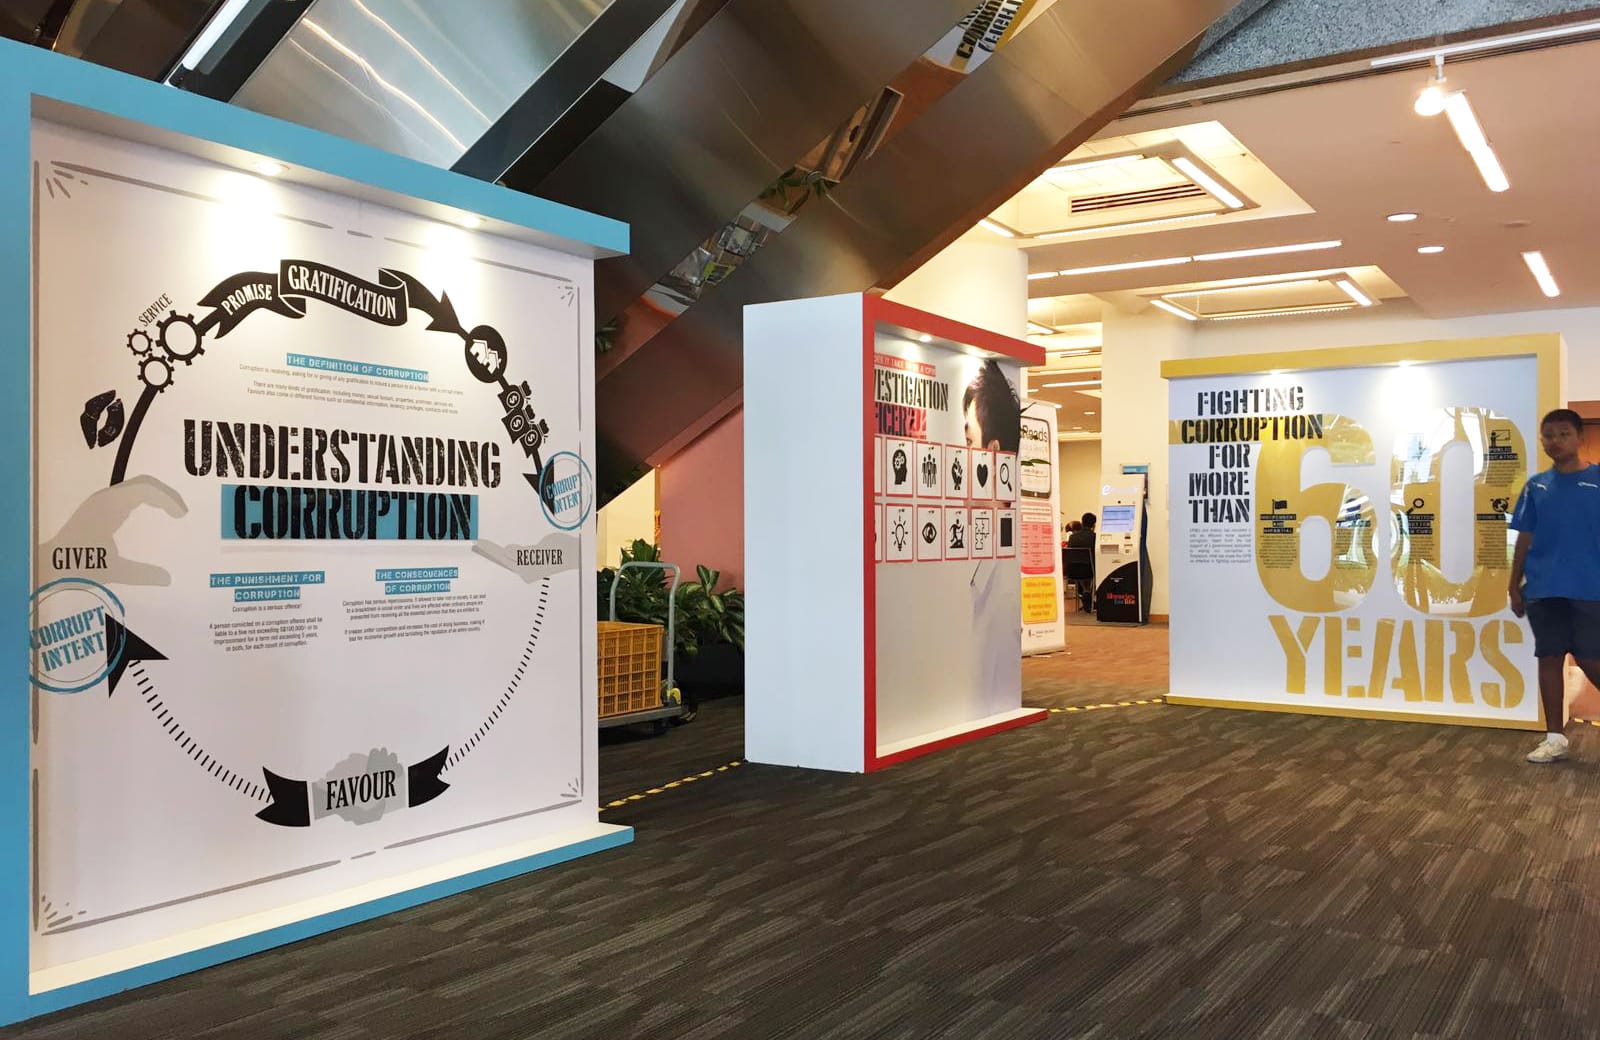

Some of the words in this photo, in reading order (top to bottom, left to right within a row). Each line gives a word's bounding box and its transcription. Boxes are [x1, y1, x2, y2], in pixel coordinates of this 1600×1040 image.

[221, 283, 272, 316] PROMISE
[287, 265, 397, 320] GRATIFICATION
[138, 292, 172, 327] SERVICE
[288, 356, 306, 366] THE
[309, 358, 359, 372] DEFINITION
[362, 365, 373, 374] OF
[376, 367, 428, 380] CORRUPTION
[1198, 386, 1304, 416] FIGHTING
[1181, 414, 1323, 444] CORRUPTION
[184, 419, 501, 488] UNDERSTANDING
[1209, 444, 1250, 469] FOR
[1189, 471, 1250, 496] MORE
[234, 484, 472, 540] CORRUPTION
[1188, 499, 1250, 523] THAN
[1256, 406, 1529, 618] 60
[52, 547, 108, 570] GIVER
[517, 549, 563, 566] RECEIVER
[211, 576, 231, 585] THE
[234, 575, 298, 585] PUNISHMENT
[302, 574, 321, 582] FOR
[377, 571, 392, 580] THE
[394, 569, 458, 579] CONSEQUENCES
[386, 585, 397, 593] OF
[400, 583, 450, 592] CORRUPTION
[235, 590, 300, 600] CORRUPTION
[42, 631, 104, 672] INTENT
[1267, 615, 1525, 709] YEARS
[326, 770, 396, 811] FAVOUR
